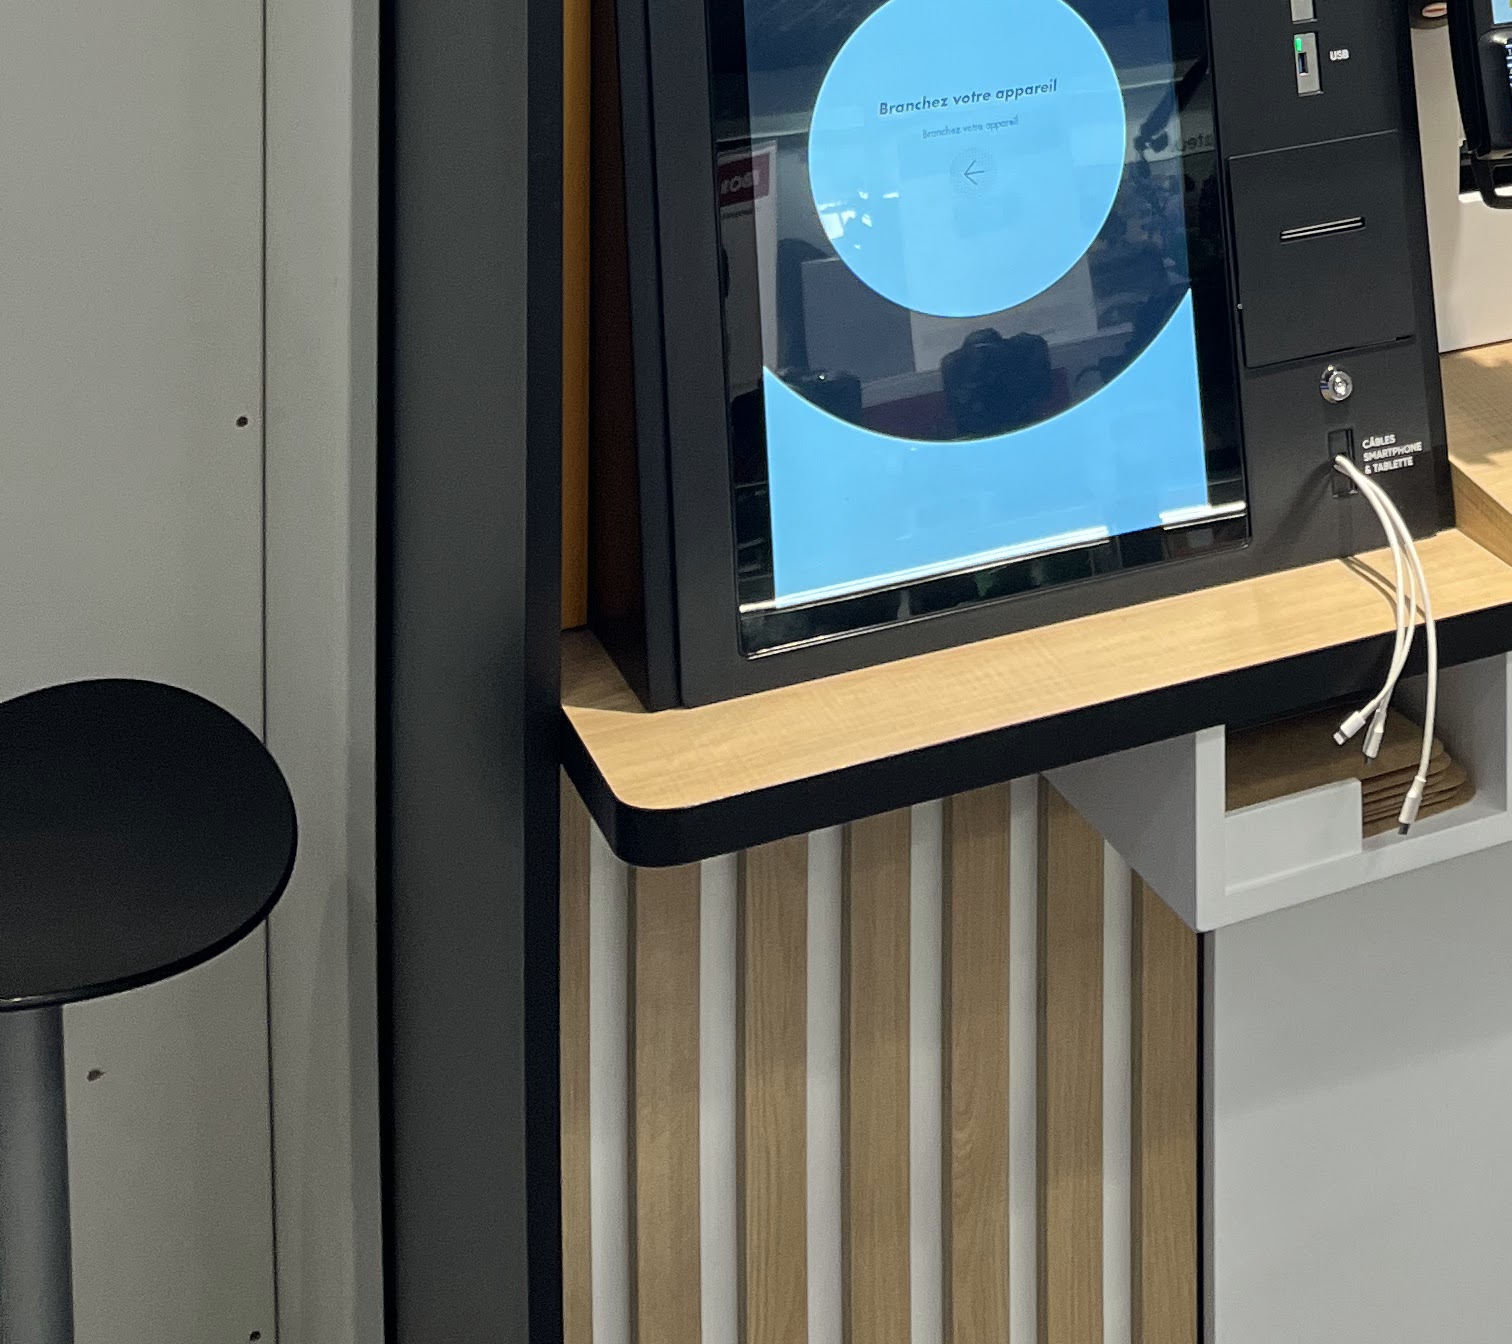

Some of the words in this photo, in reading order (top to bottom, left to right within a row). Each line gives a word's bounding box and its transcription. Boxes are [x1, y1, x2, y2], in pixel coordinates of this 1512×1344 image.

[1329, 49, 1349, 61] USB
[879, 95, 948, 116] Branchez
[953, 91, 991, 106] votre
[995, 79, 1057, 100] appareil
[1363, 441, 1422, 462] SMARTPHONE
[1372, 456, 1413, 472] TABLETTE
